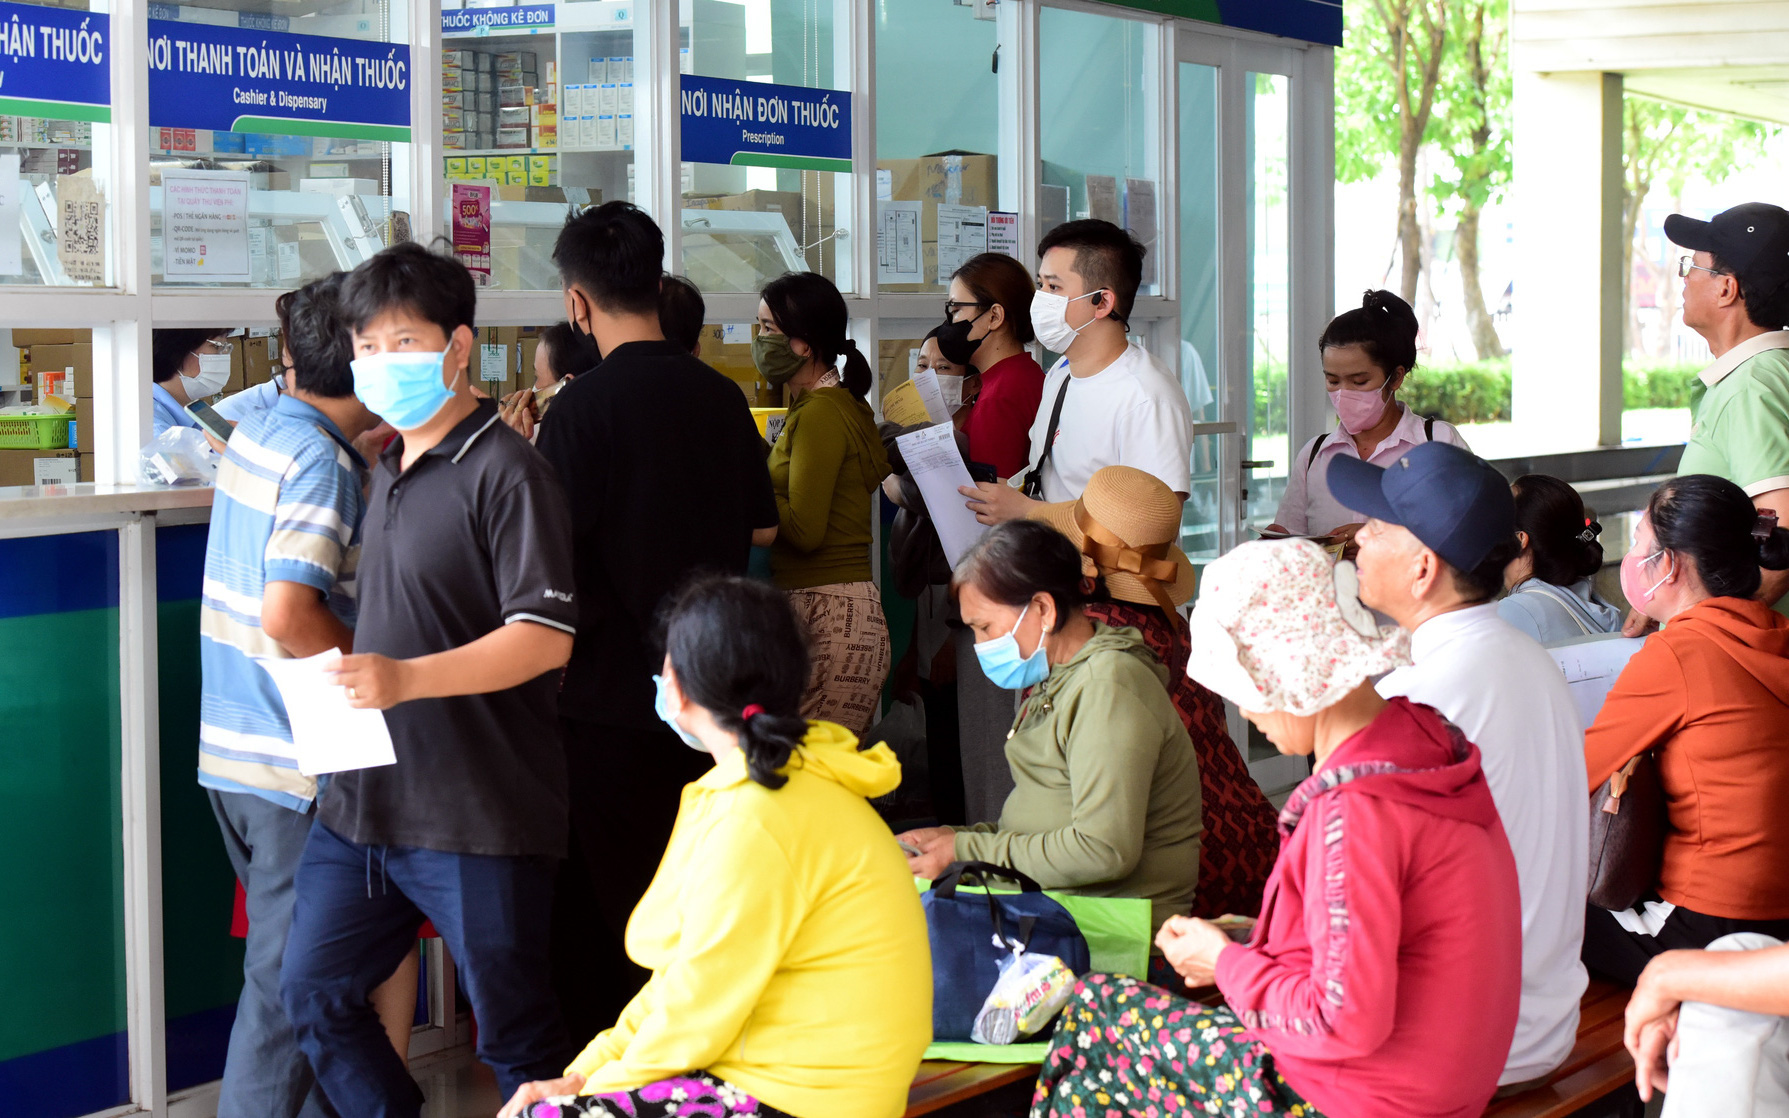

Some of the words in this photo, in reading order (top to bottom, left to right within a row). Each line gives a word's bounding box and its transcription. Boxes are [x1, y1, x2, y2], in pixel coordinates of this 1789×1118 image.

[442, 11, 471, 28] HUỐC
[473, 12, 509, 27] KHÔNG
[511, 9, 525, 24] KÊ
[527, 11, 549, 24] ĐƠN
[40, 17, 102, 65] THUỐC
[148, 35, 171, 71] NƠI
[176, 41, 232, 75] THANH
[237, 40, 280, 79] TOÁN
[284, 44, 306, 81] VÀ
[310, 47, 352, 91] NHẬN
[355, 48, 406, 90] THUỐC
[233, 87, 267, 105] Cashier
[270, 91, 276, 106] &
[279, 91, 327, 113] Dispensary
[681, 88, 707, 117] NƠI
[712, 88, 753, 125] NHẬN
[757, 96, 788, 124] ĐƠN
[792, 94, 839, 129] THUỐC
[742, 129, 785, 147] Prescription
[844, 597, 853, 638] BURBERRY
[833, 674, 871, 685] BURBERRY
